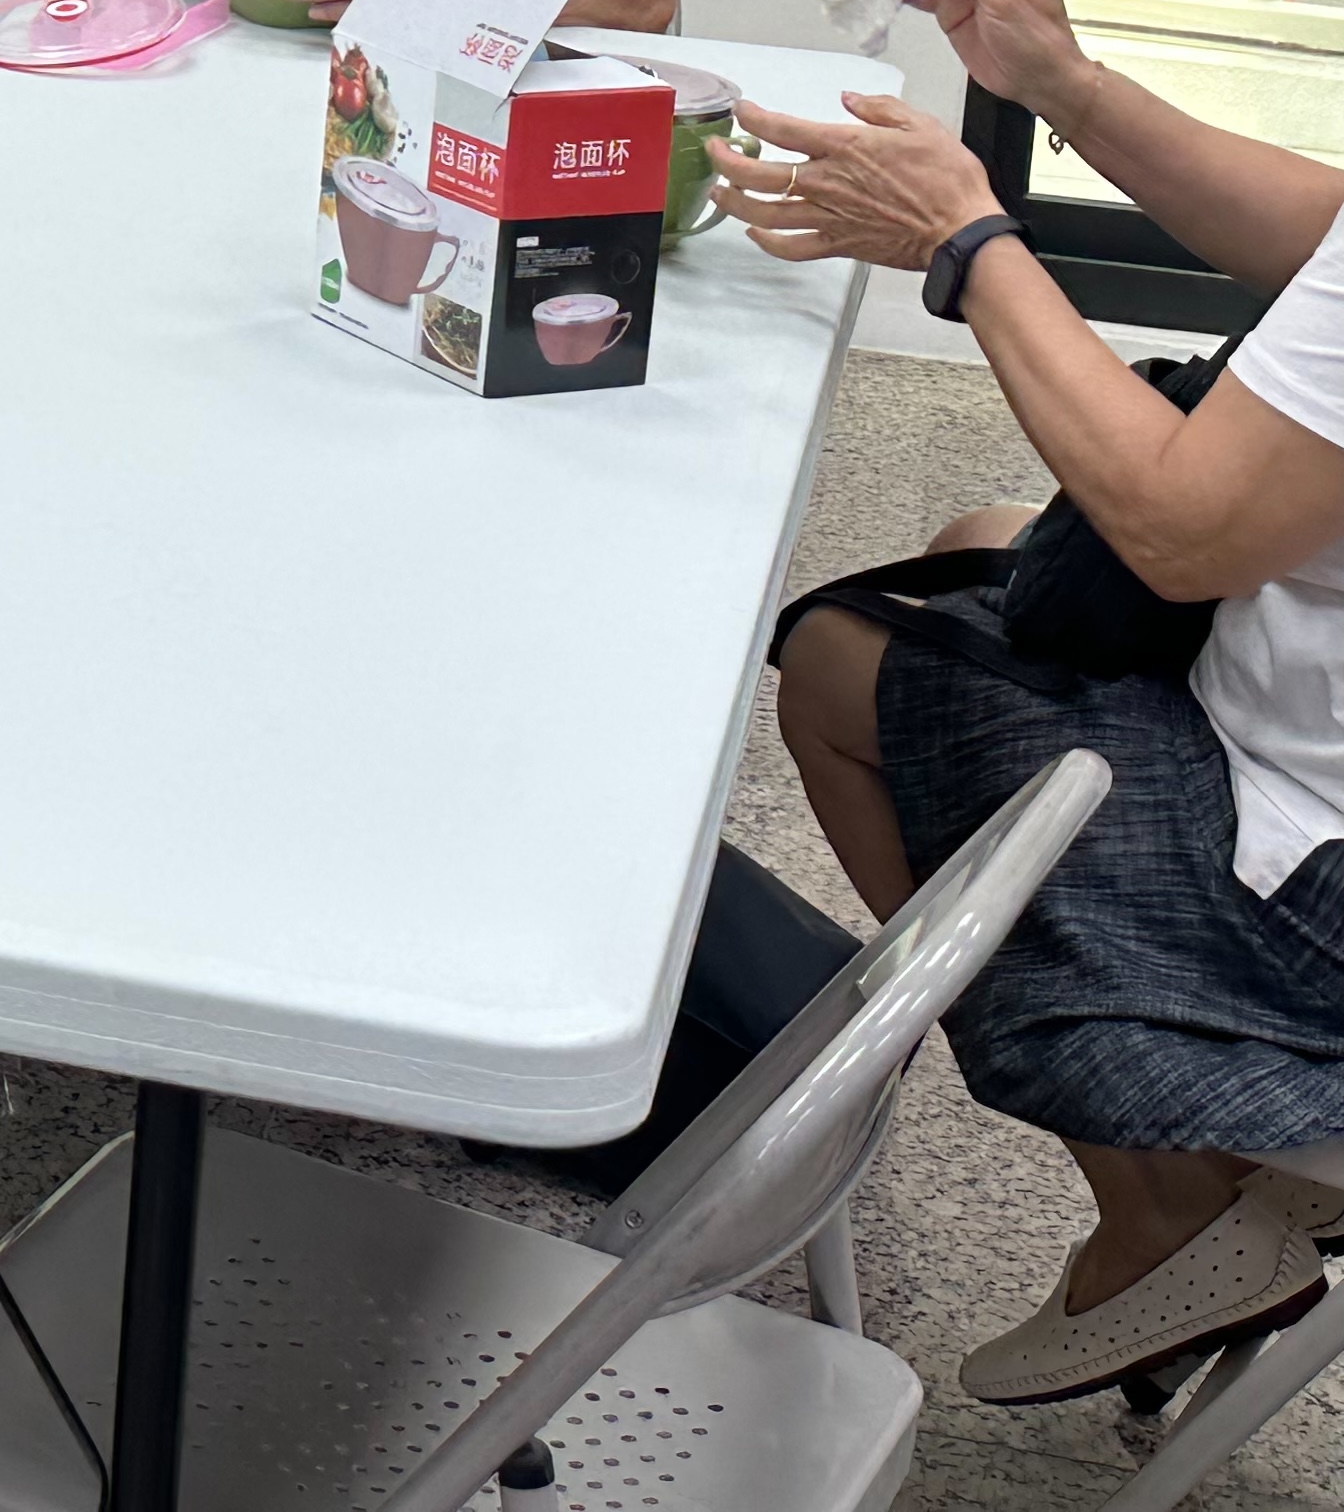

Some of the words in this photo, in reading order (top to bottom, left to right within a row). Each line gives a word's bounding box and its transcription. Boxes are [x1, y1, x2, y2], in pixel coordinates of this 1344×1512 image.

[435, 131, 501, 185] 泡面杯
[552, 139, 632, 170] 泡面杯
